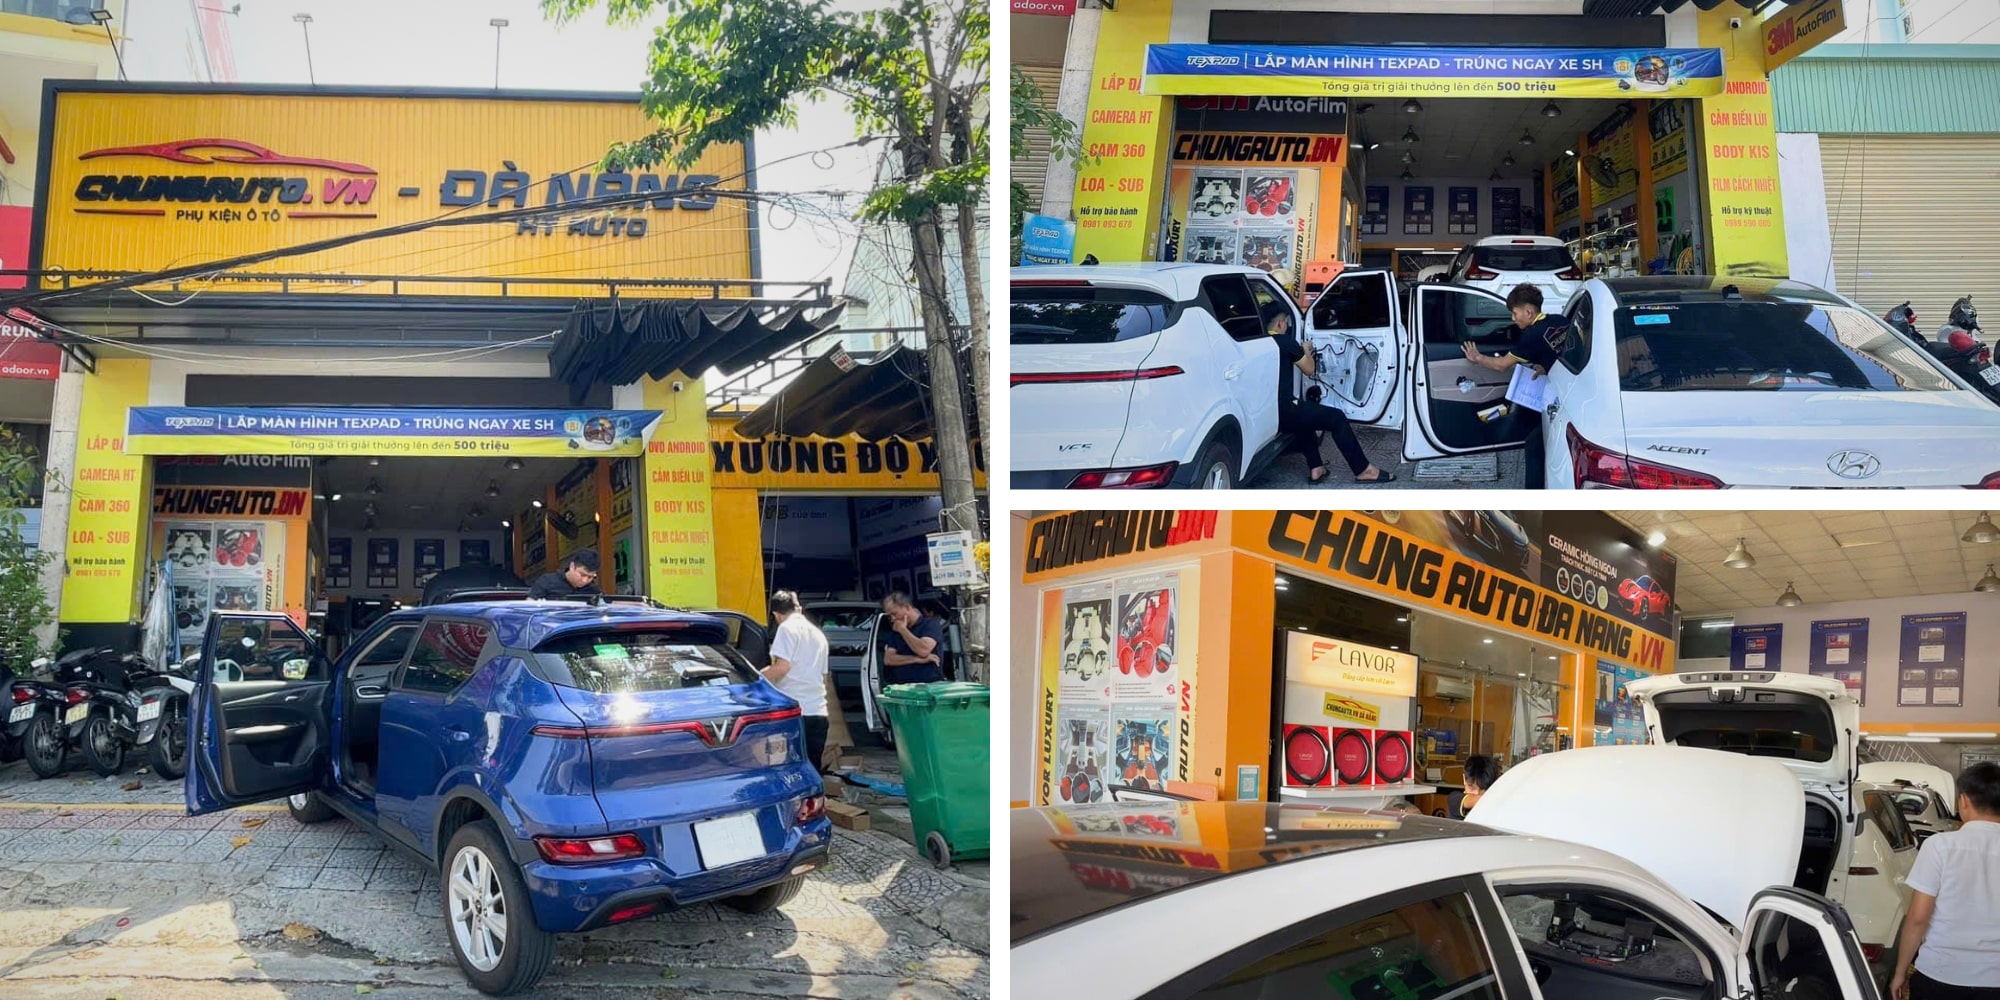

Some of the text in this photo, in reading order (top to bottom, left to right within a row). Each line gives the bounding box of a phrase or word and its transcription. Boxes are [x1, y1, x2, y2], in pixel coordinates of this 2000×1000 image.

[1013, 0, 1065, 11] adoor.vn
[1767, 8, 1837, 56] 3M AutoFilm
[1186, 55, 1240, 68] TEXPAD
[1254, 52, 1287, 68] LẮP
[1291, 54, 1330, 69] MÀN
[1333, 54, 1374, 69] HÌNH
[1378, 57, 1441, 69] TEXPAD
[1454, 55, 1508, 70] TRÚNG
[1512, 58, 1555, 70] NGAY
[1558, 59, 1578, 70] XE
[1582, 59, 1603, 70] SH
[1101, 72, 1125, 91] LẮP
[1321, 80, 1556, 94] Tổng giá trị giải thưởng lên đến 500 triệu
[1726, 81, 1767, 95] ANDROID
[1255, 96, 1347, 114] AutoFilm
[1091, 109, 1153, 124] CAMERA HT
[1710, 109, 1730, 126] CẢM
[1732, 108, 1752, 126] BIẾN
[1089, 143, 1146, 158] CAM 360
[1713, 145, 1770, 159] BODY KIS
[440, 160, 530, 208] ĐÀ
[1080, 177, 1105, 192] LOA
[1118, 178, 1144, 192] SUB
[1712, 175, 1777, 195] FILM CÁCH NHIỆT
[176, 208, 281, 223] PHỤ KIỆN Ô TÔ
[1080, 205, 1138, 217] Hỗ trợ bảo hành
[1721, 205, 1773, 216] Hỗ trợ kỹ thuật
[567, 217, 648, 238] AUTO
[1082, 219, 1100, 228] 0981
[1102, 220, 1118, 228] 093
[1293, 217, 1306, 299] CHUNGAUTO.VN
[2, 364, 49, 376] adoor.vn
[164, 416, 215, 430] TEXPAD
[227, 414, 257, 429] LẮP
[261, 415, 297, 429] MÀN
[300, 415, 338, 429] HÌNH
[342, 417, 401, 430] TEXPAD
[413, 415, 465, 430] TRÚNG
[468, 418, 509, 430] NGAY
[512, 419, 531, 430] XE
[534, 419, 554, 430] SH
[413, 441, 429, 451] lên
[453, 441, 477, 451] 500
[480, 440, 510, 453] triệu
[667, 441, 706, 454] ANDROID
[711, 431, 847, 474] XƯỞNG
[1646, 444, 1711, 456] ACCENT
[223, 455, 311, 468] AutoFilm
[80, 468, 136, 482] CAMERA HT
[79, 499, 130, 513] CAM 360
[654, 500, 705, 513] BODY KIS
[72, 530, 95, 544] LOA
[106, 531, 130, 544] SUB
[652, 531, 669, 544] FILM
[1548, 534, 1580, 559] CERAMIC
[1580, 548, 1598, 569] HỒNG
[1599, 560, 1618, 579] NGOẠI
[1268, 510, 1445, 599] CHUNG
[1443, 560, 1536, 628] AUTO
[1339, 647, 1395, 674] LAVOR
[1043, 687, 1055, 762] LUXURY
